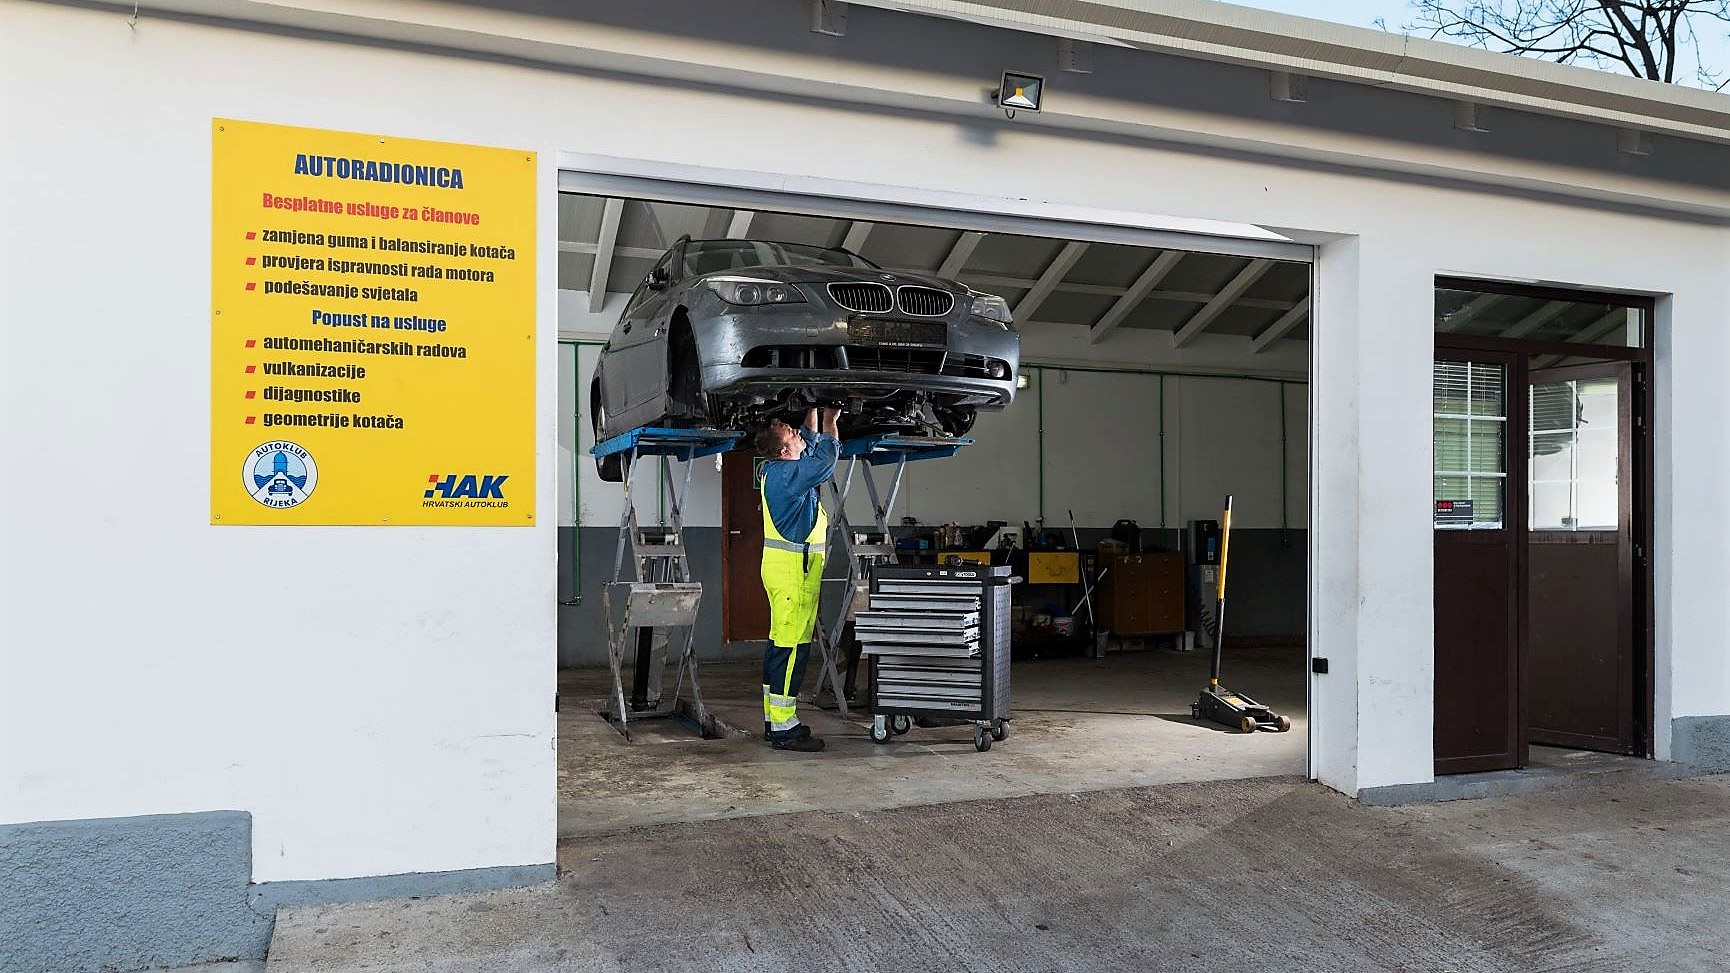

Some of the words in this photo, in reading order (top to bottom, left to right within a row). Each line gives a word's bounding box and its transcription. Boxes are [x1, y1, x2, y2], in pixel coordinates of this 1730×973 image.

[294, 154, 463, 189] AUTORADIONICA
[263, 193, 343, 214] Besplatne
[347, 202, 399, 219] usluge
[403, 208, 418, 220] za
[422, 207, 479, 225] članove
[263, 230, 324, 245] zamjena
[328, 235, 368, 249] guma
[372, 236, 375, 249] i
[379, 237, 467, 257] balansiranje
[470, 244, 515, 260] kotača
[263, 256, 324, 270] provjera
[328, 258, 408, 276] ispravnosti
[412, 265, 442, 279] rada
[446, 269, 494, 282] motora
[265, 281, 358, 299] podešavanje
[362, 286, 417, 302] svjetala
[312, 310, 367, 327] Popust
[371, 316, 390, 328] na
[394, 316, 446, 333] usluge
[264, 337, 413, 355] automehaničarskih
[417, 344, 466, 358] radova
[263, 362, 365, 379] vulkanizacije
[264, 386, 360, 403] dijagnostike
[264, 414, 349, 428] geometrije
[353, 414, 403, 429] kotača
[255, 443, 308, 459] AUTOKLUB
[423, 474, 509, 499] HAK
[263, 497, 299, 507] RIJEKA
[422, 500, 463, 508] HRVATSKI
